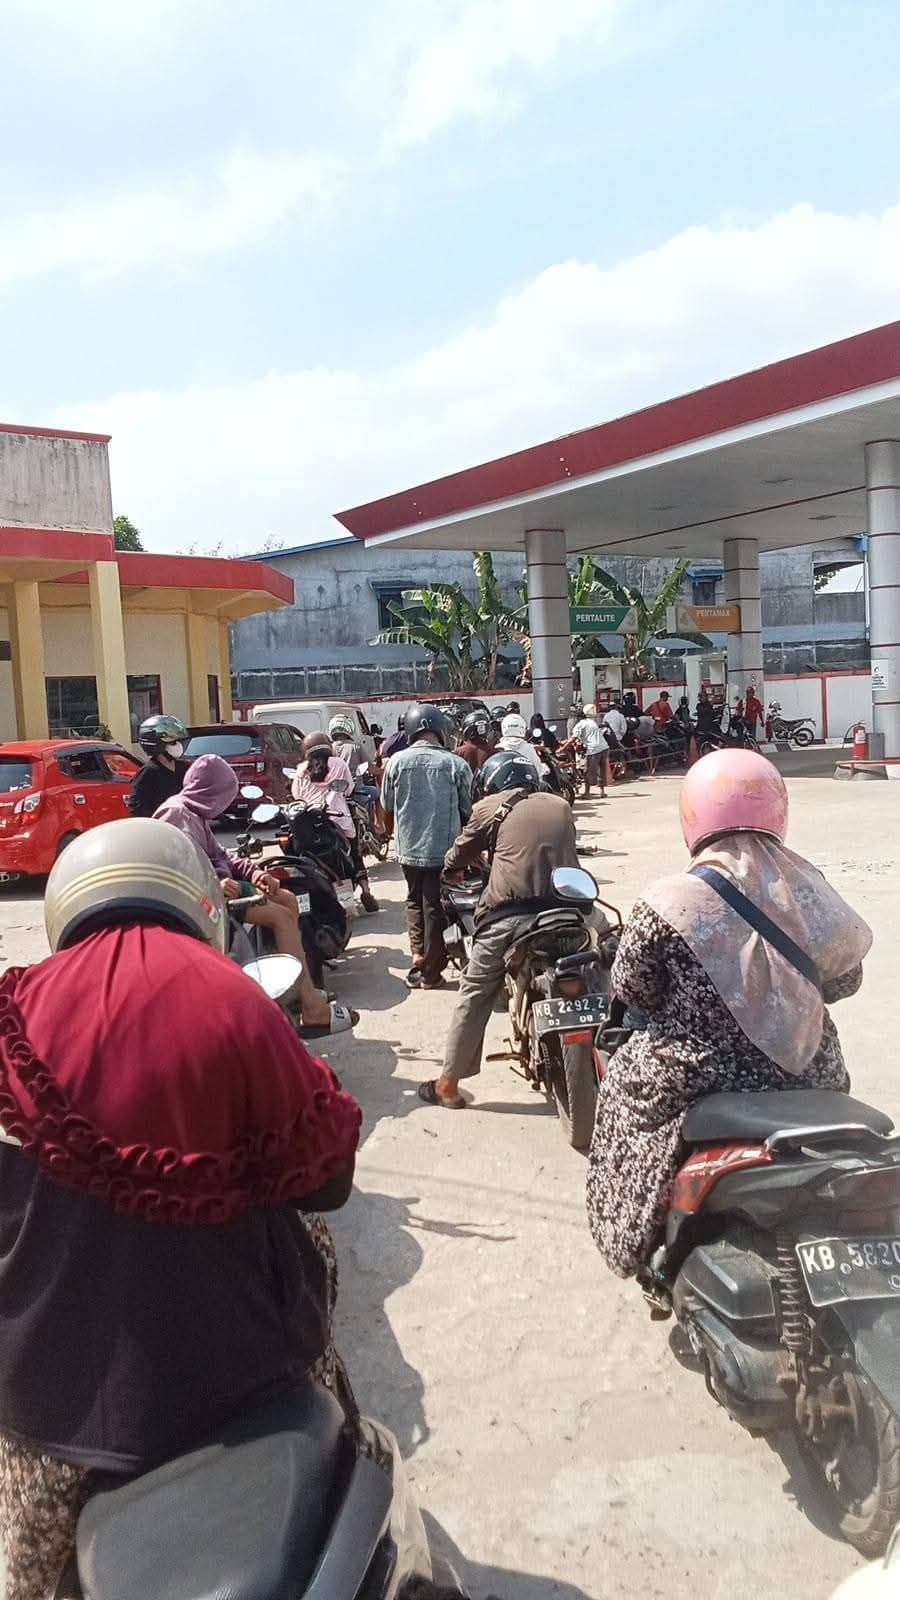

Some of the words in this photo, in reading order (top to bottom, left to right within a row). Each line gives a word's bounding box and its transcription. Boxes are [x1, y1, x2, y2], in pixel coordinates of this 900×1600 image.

[575, 614, 616, 622] PERTALITE
[696, 609, 730, 617] PERTAMAX
[535, 1003, 552, 1017] KB
[558, 998, 590, 1014] 2292
[802, 1245, 835, 1274] KB
